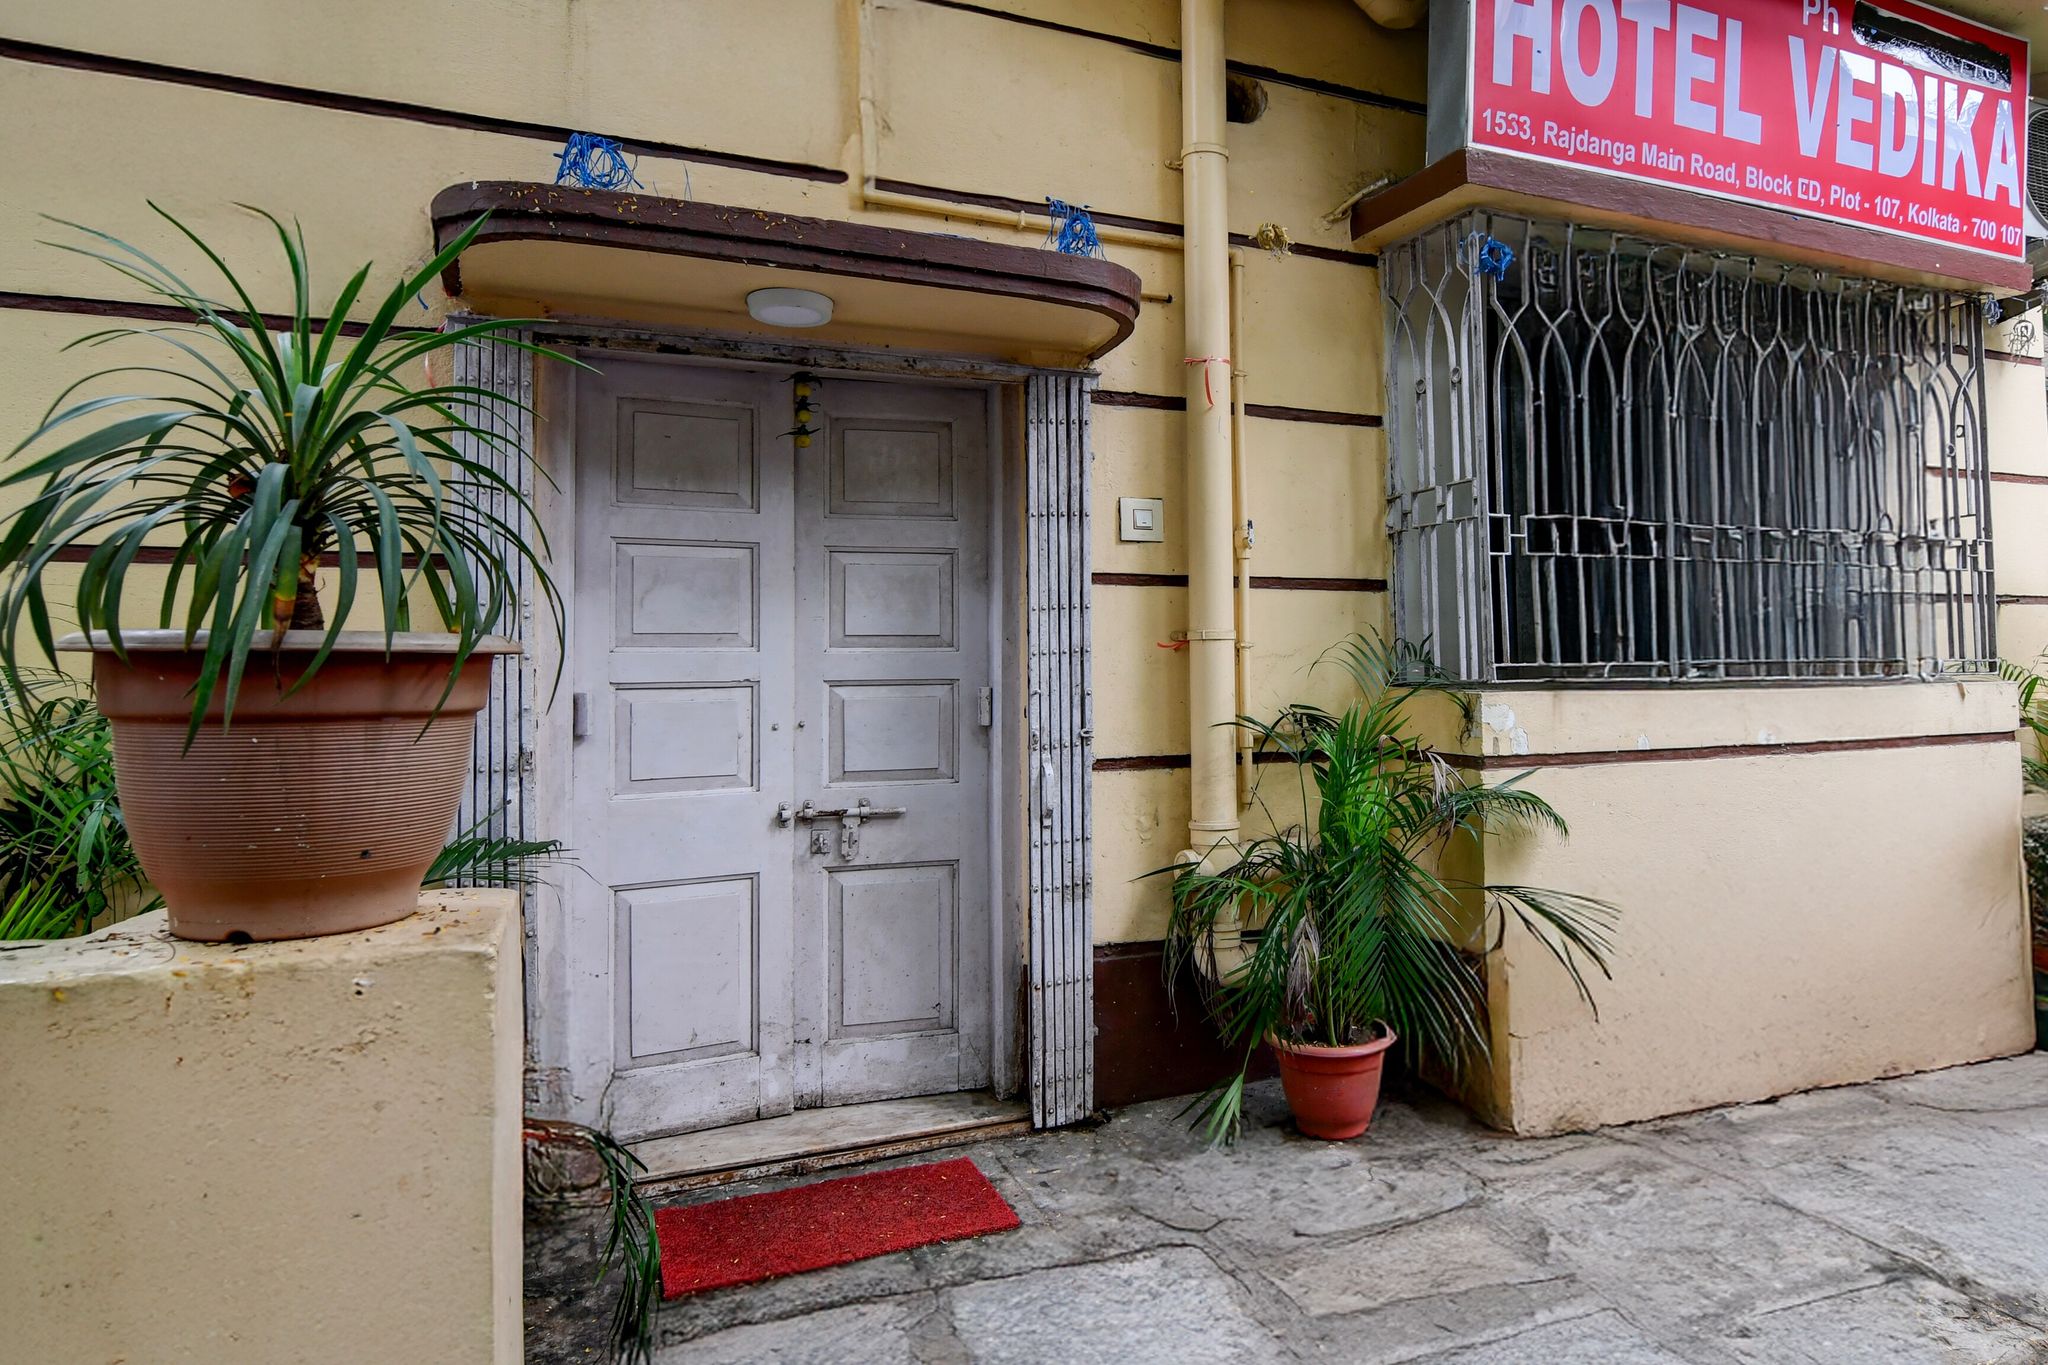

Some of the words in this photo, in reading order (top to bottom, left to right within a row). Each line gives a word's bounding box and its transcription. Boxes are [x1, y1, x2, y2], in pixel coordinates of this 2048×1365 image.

[1803, 0, 1841, 36] Ph
[1491, 0, 1763, 146] HOTEL
[1788, 35, 2021, 209] VEDIKA
[1543, 120, 1636, 166] Rajdanga
[1641, 142, 1685, 173] Main
[1690, 154, 1740, 189] Road,
[1745, 165, 1793, 197] Block
[1829, 184, 1861, 212] Plot
[1874, 195, 1903, 224] 107,
[1907, 202, 1960, 234] Kolkata
[1971, 217, 1997, 241] 700
[2000, 224, 2022, 246] 107
